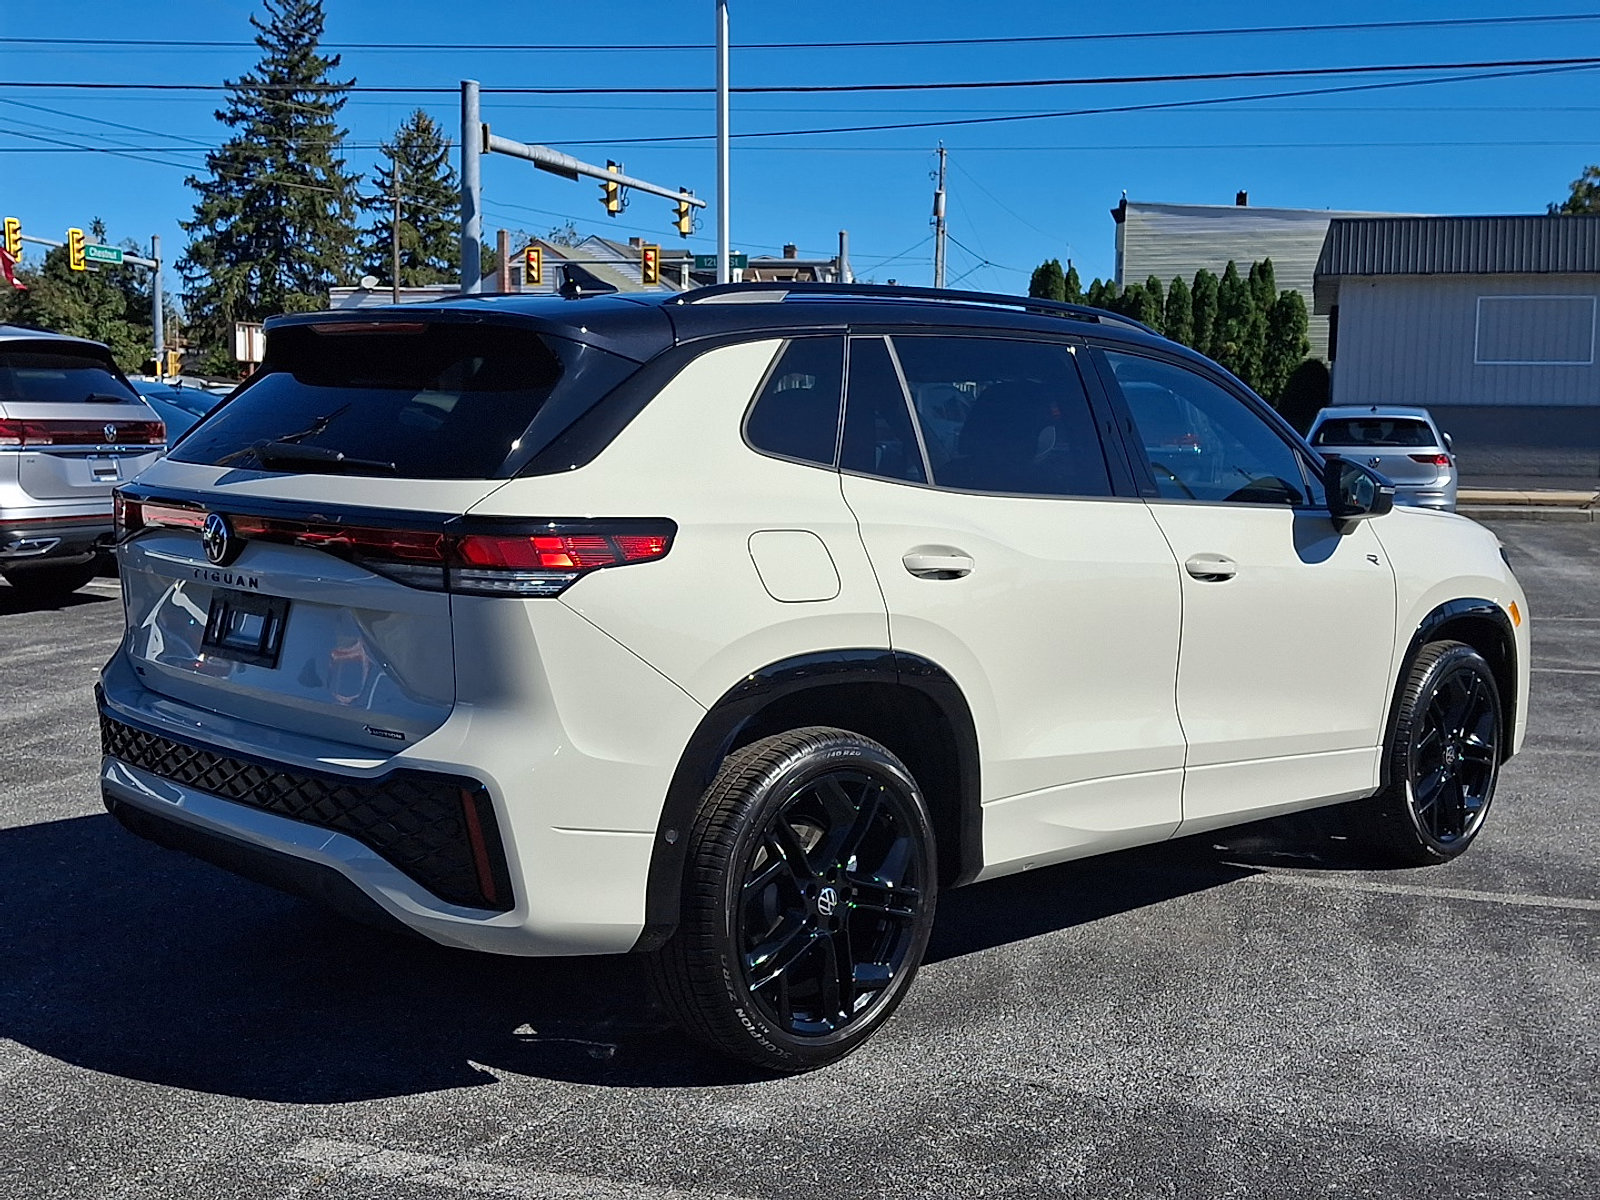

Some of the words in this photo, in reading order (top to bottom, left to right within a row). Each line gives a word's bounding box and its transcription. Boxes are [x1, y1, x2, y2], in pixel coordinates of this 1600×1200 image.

[89, 247, 117, 259] Chestnut
[704, 258, 718, 267] 12t
[193, 568, 259, 589] TIGUAN
[735, 1008, 793, 1059] SCORPION
